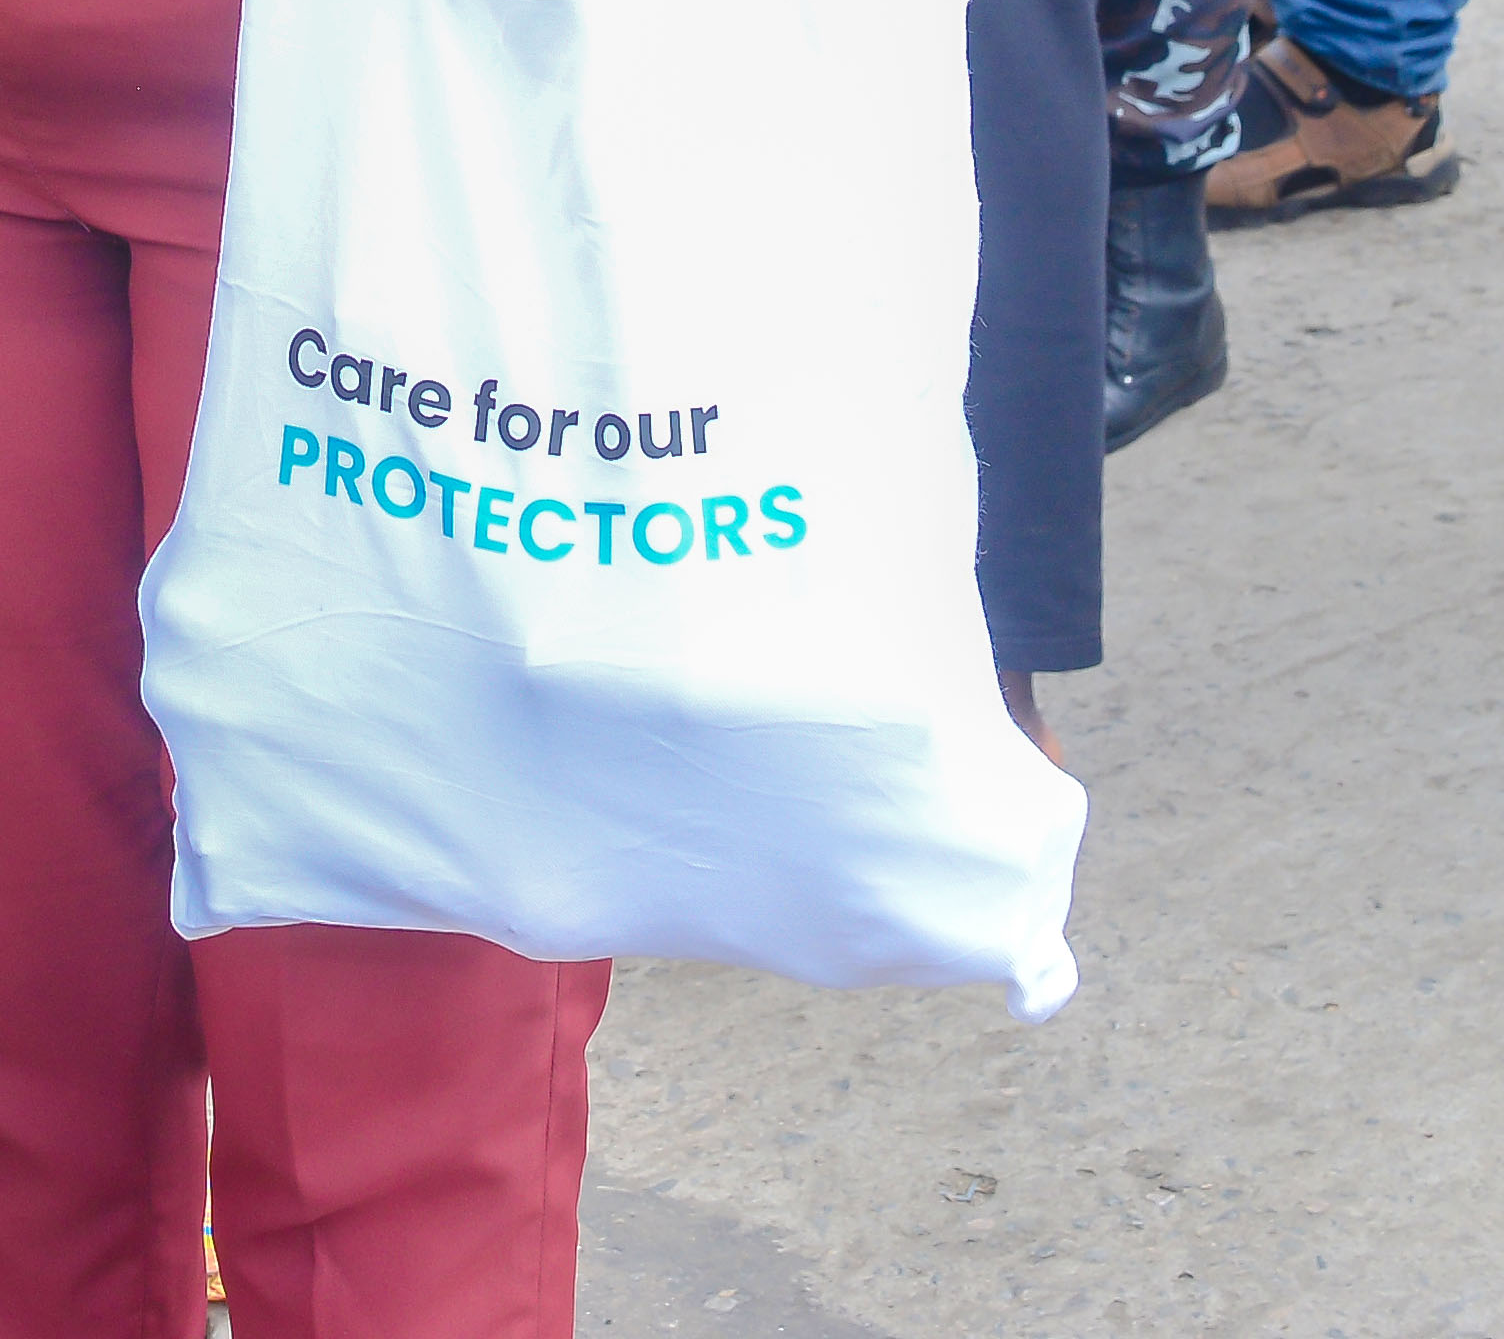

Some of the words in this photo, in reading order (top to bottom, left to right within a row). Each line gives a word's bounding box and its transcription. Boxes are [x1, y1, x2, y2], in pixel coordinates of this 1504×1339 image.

[288, 328, 451, 428] Care
[473, 379, 579, 457] for
[594, 403, 719, 461] our
[278, 424, 809, 566] PROTECTORS
